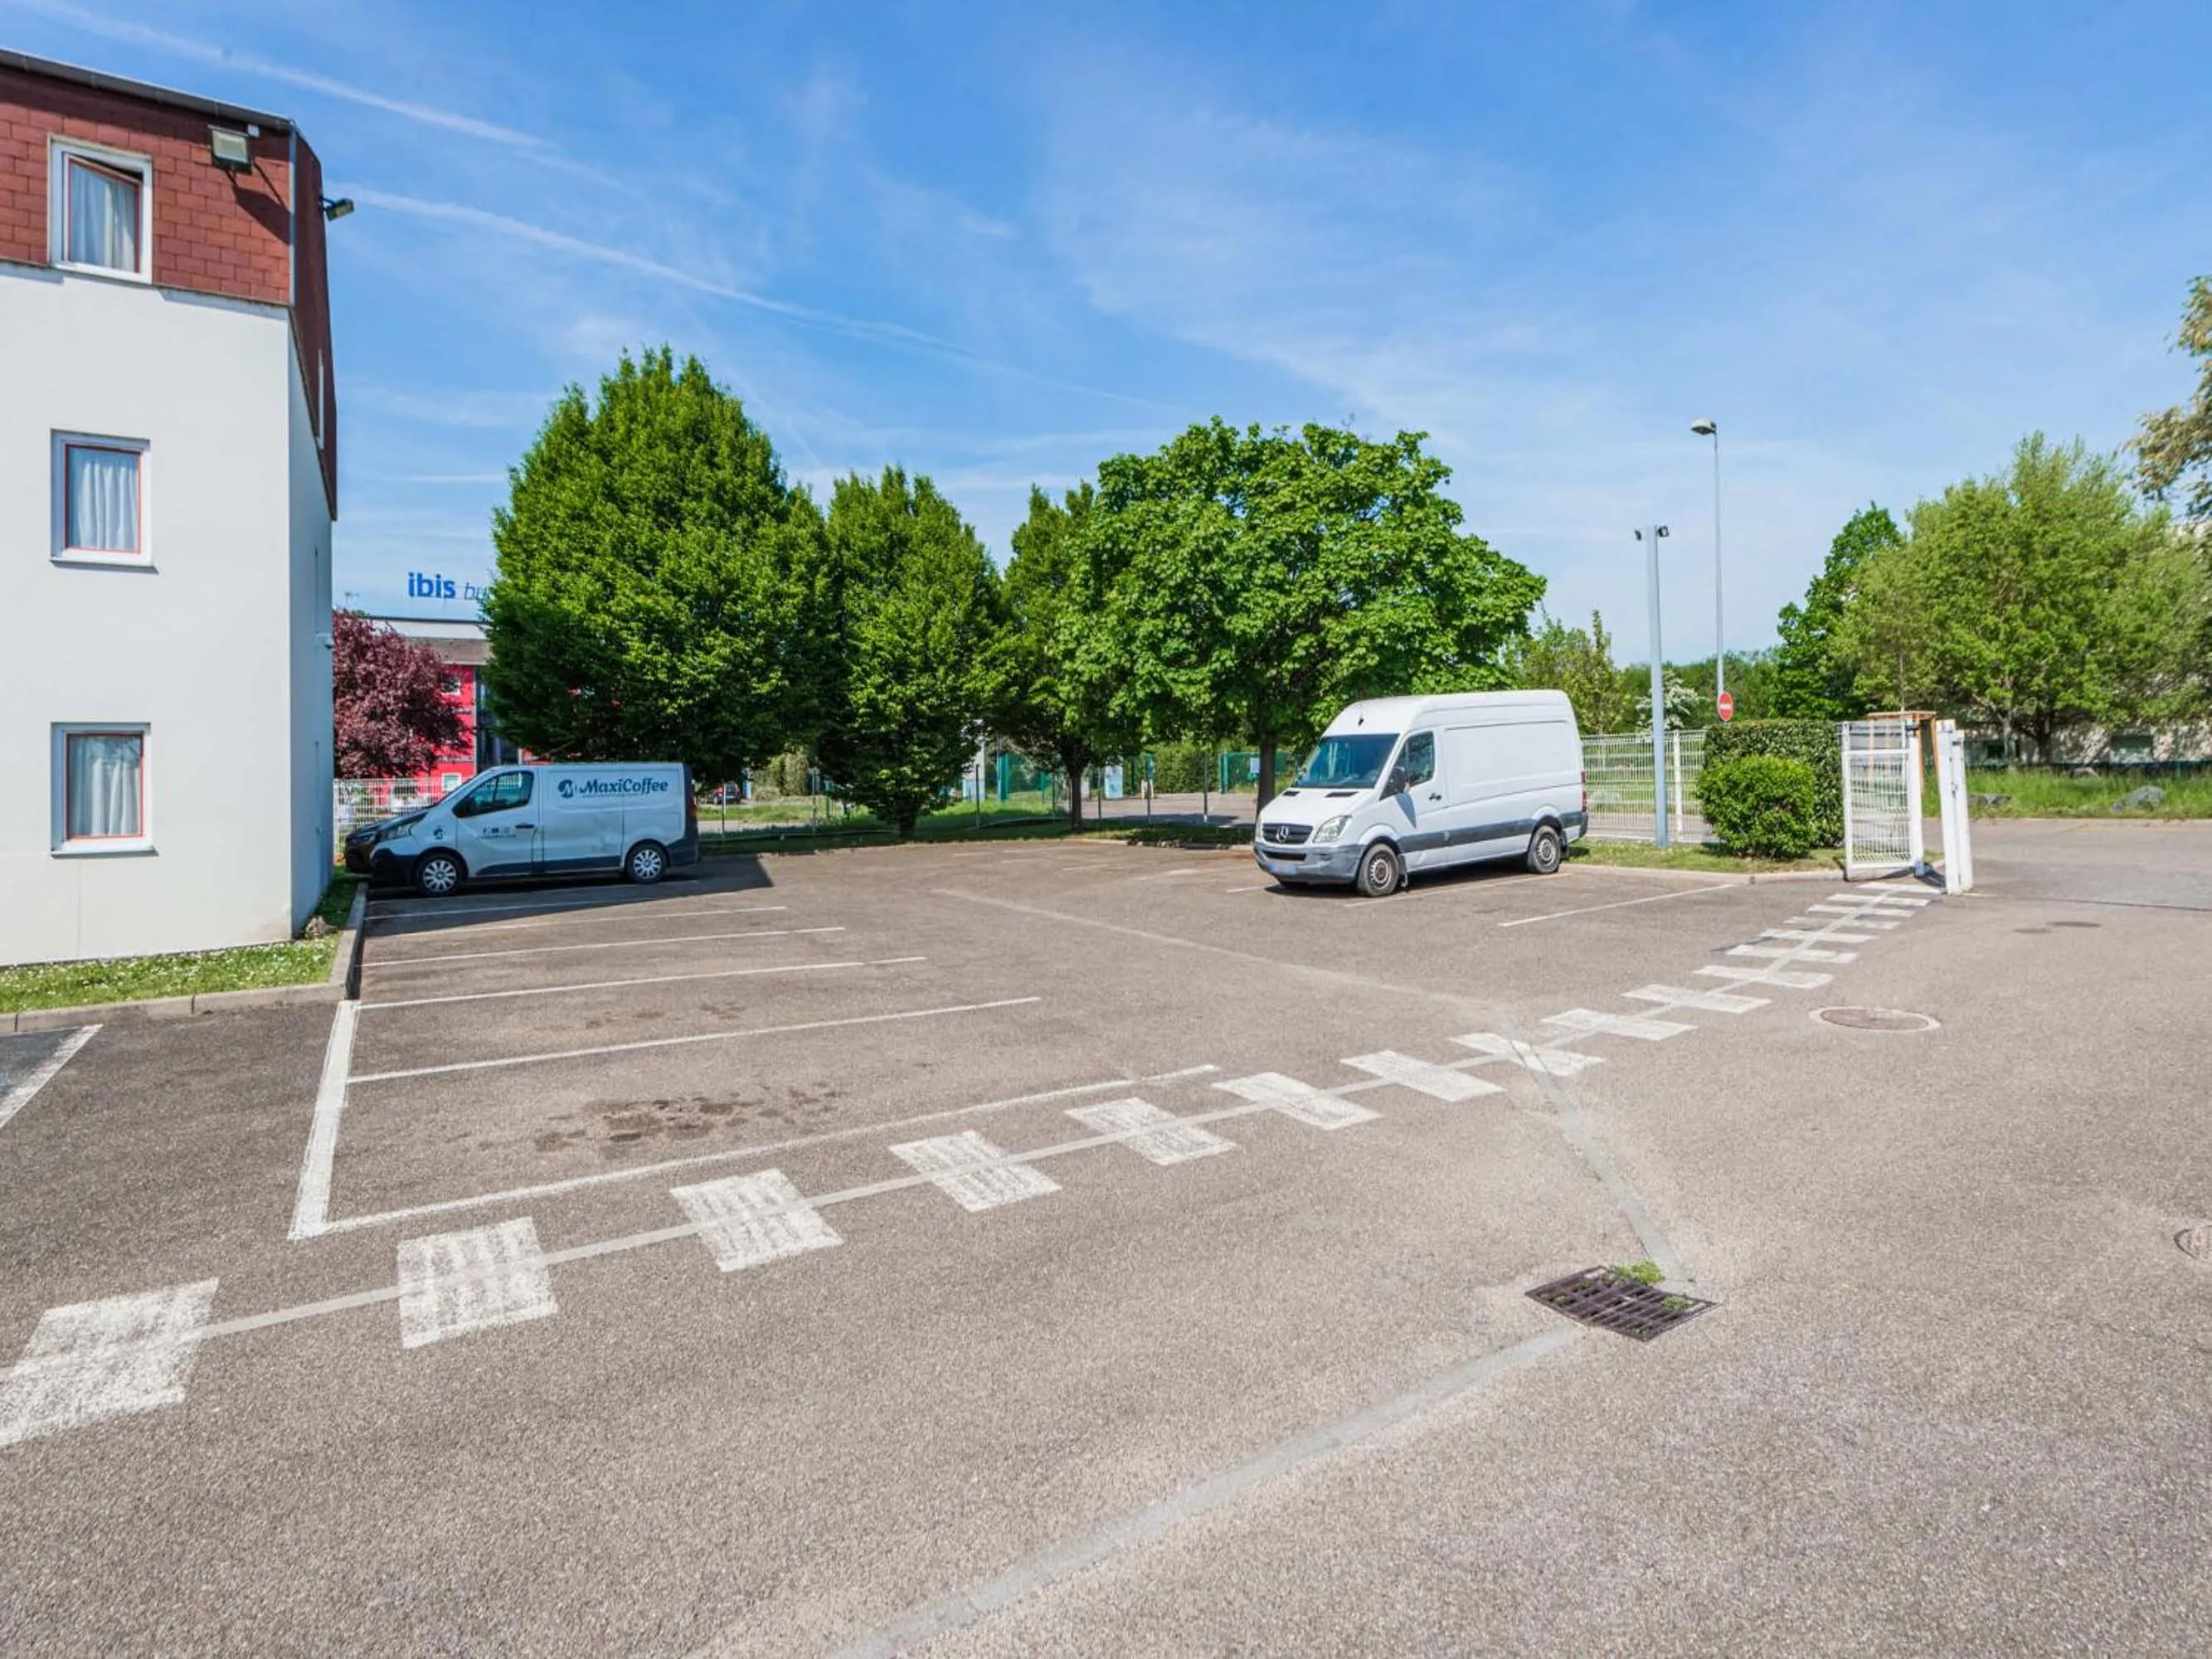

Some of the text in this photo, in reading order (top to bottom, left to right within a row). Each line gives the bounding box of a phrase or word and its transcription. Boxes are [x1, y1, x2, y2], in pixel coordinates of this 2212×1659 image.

[408, 572, 490, 601] ibis bu
[579, 778, 668, 795] MaxiCoffee
